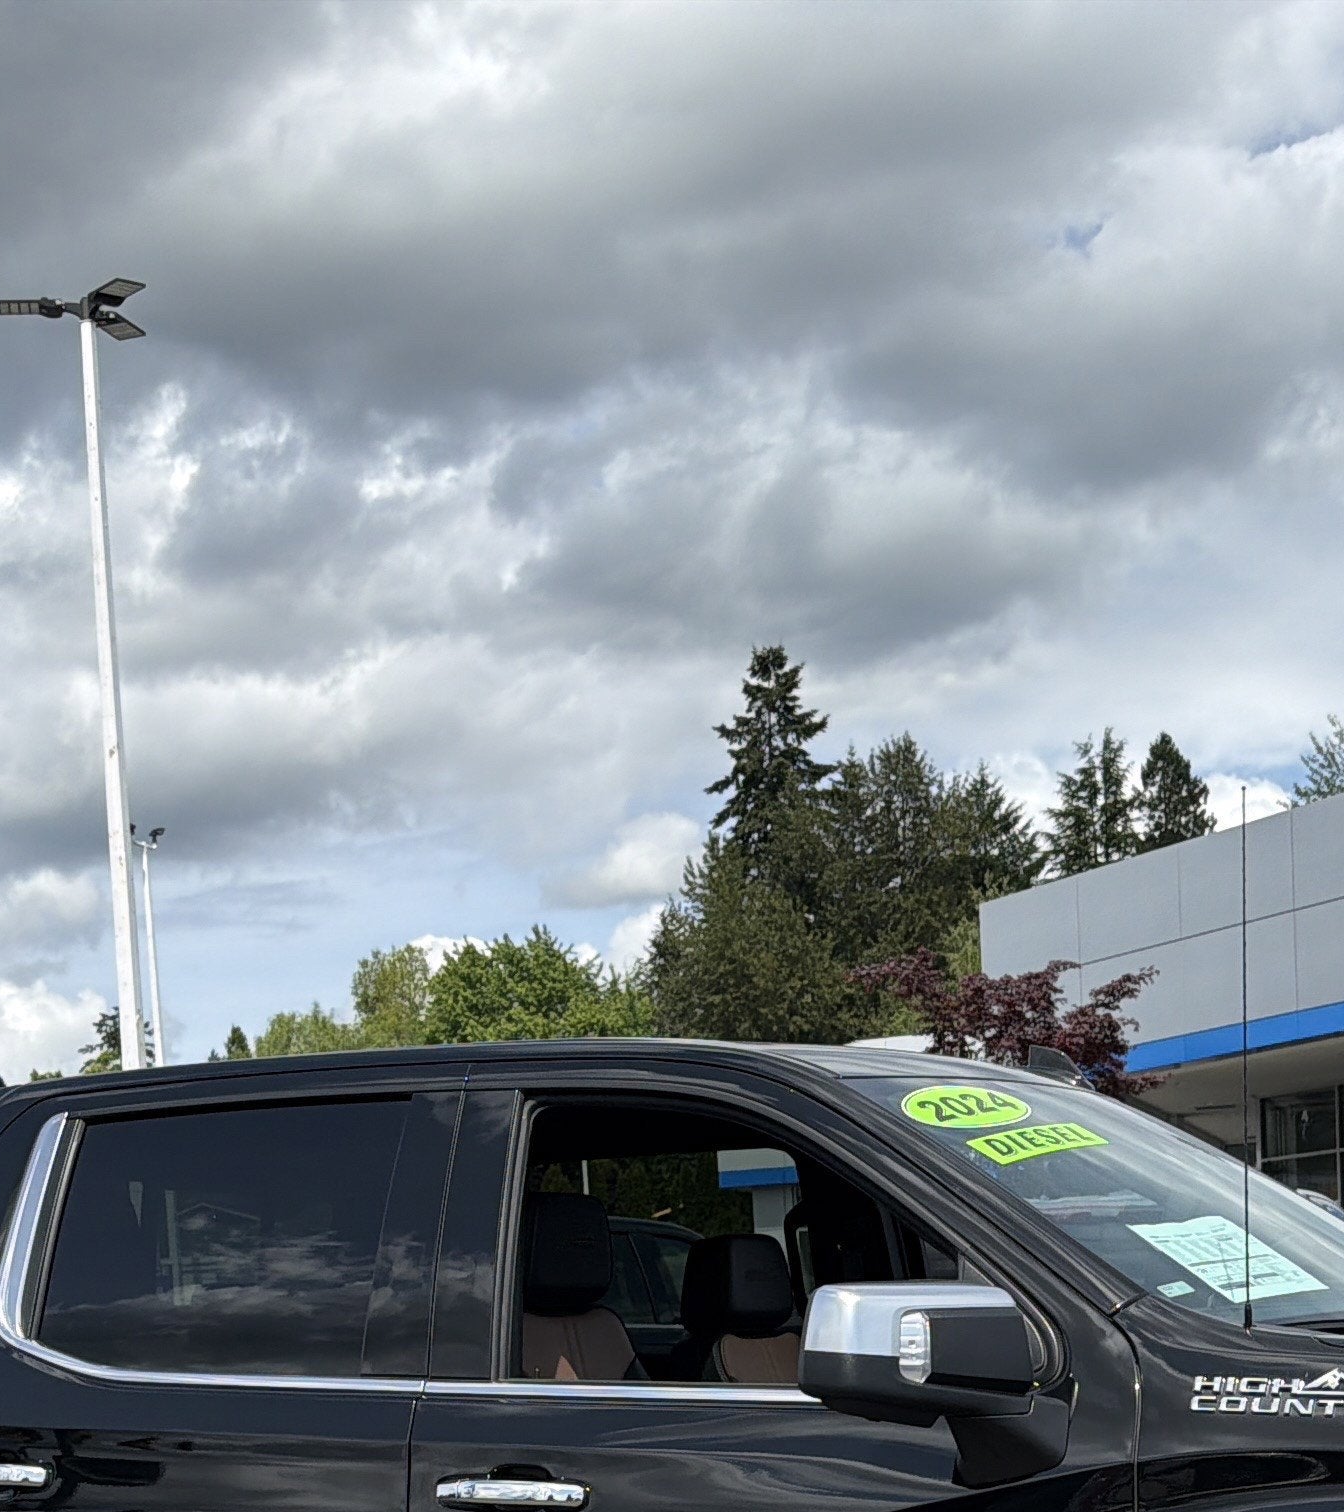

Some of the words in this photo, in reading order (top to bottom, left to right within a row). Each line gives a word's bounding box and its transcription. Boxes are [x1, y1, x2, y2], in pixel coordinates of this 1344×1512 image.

[916, 1091, 1020, 1123] 2024
[983, 1124, 1094, 1157] DIESEL
[1192, 1375, 1305, 1396] HIGH
